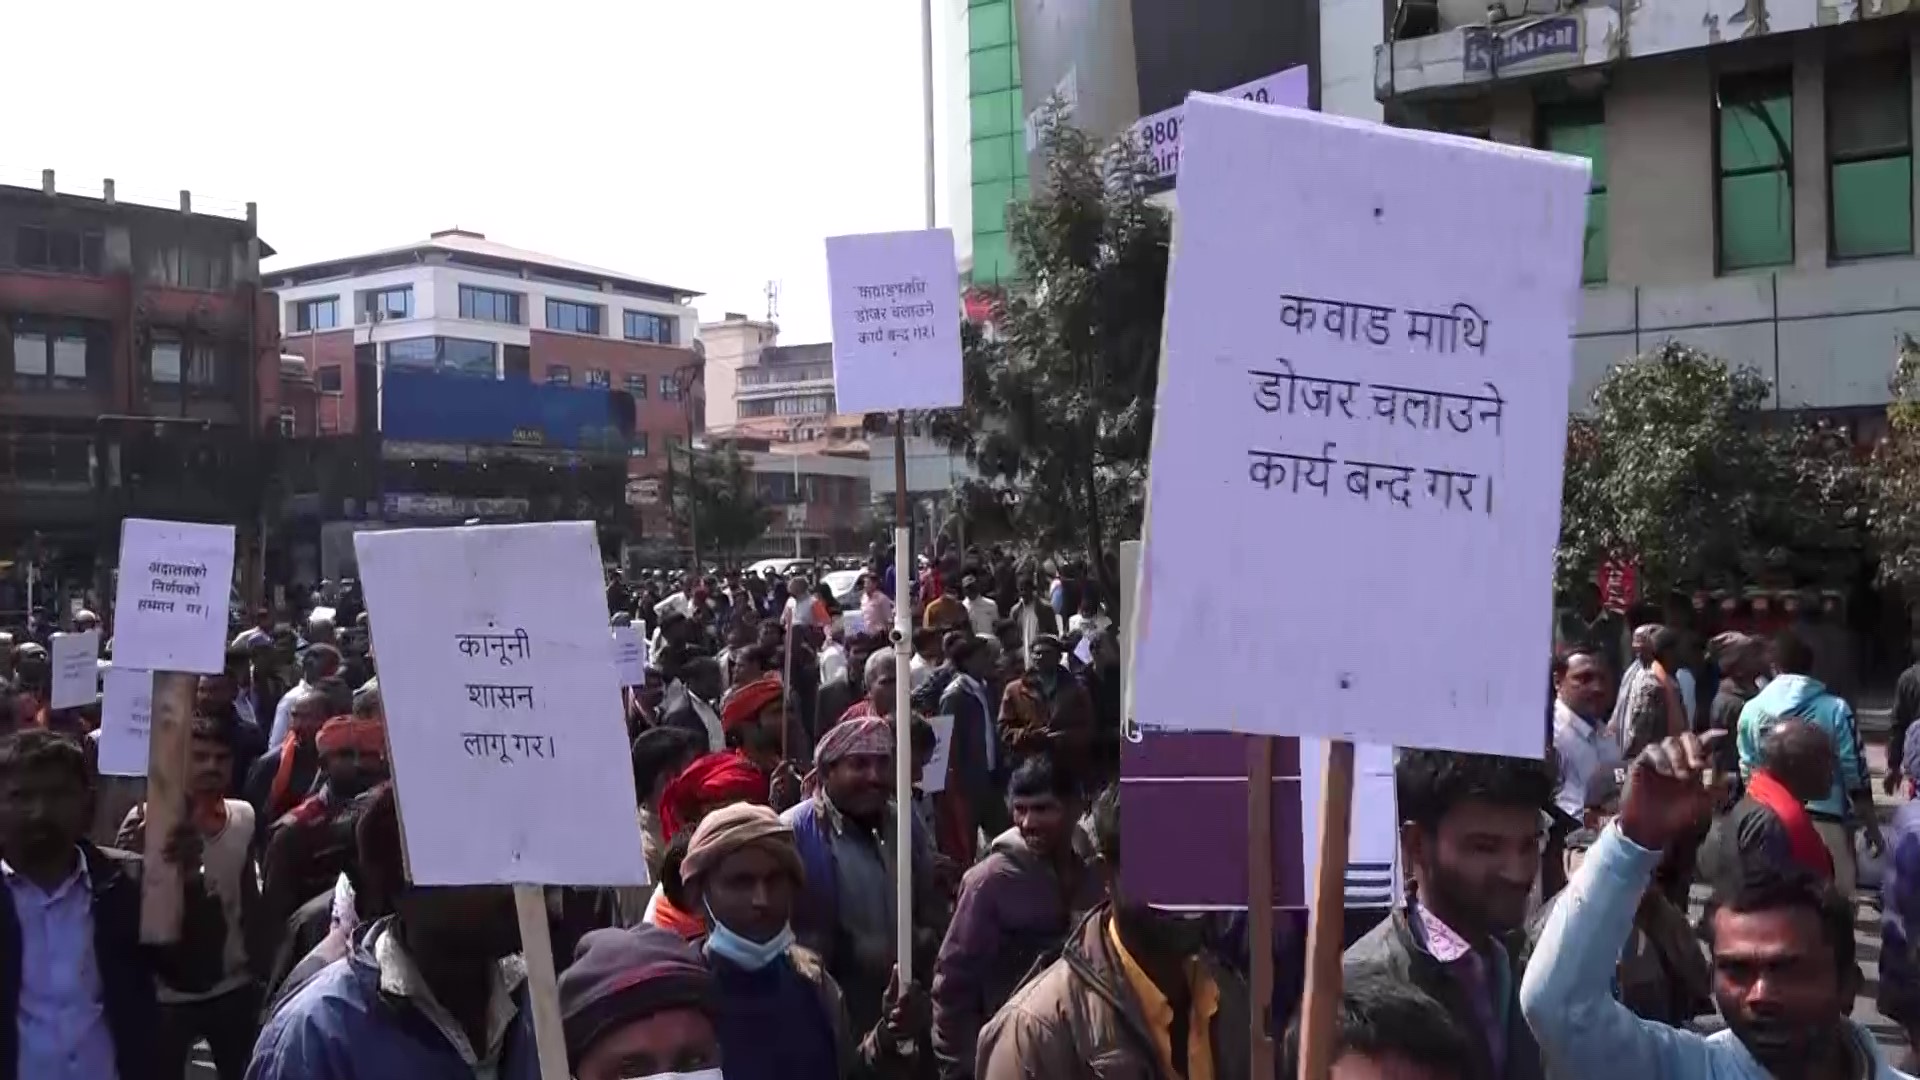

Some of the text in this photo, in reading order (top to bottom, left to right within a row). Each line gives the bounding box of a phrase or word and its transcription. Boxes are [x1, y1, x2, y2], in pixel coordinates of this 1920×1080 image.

[1404, 301, 1492, 355] माथि
[1248, 358, 1507, 436] डोजर चलाउने
[1248, 441, 1337, 496] कार्य
[1344, 460, 1416, 508] बन्द
[455, 628, 531, 666] कानूनी
[464, 684, 533, 710] शासन
[460, 732, 513, 764] लागू
